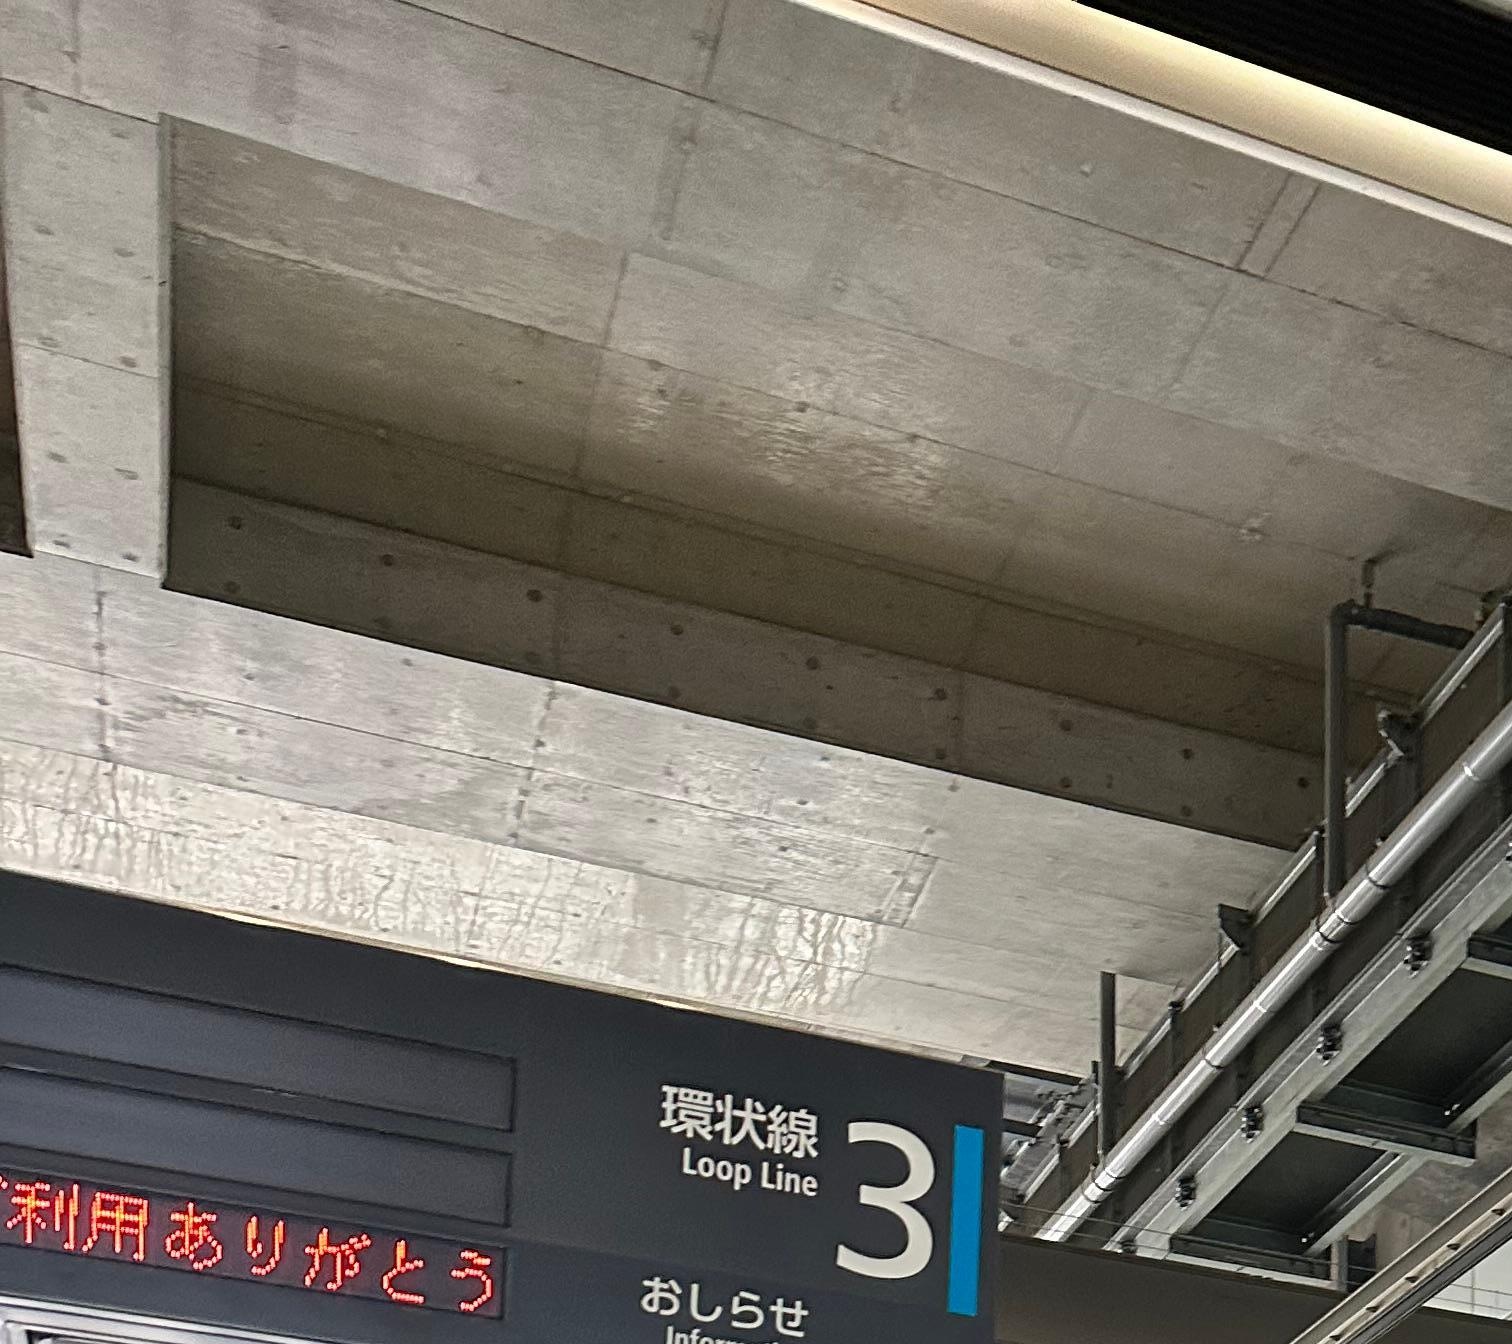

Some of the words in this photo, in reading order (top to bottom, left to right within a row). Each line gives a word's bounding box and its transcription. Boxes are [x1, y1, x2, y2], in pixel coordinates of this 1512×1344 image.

[659, 1084, 819, 1158] 環状線
[682, 1146, 752, 1191] Loop
[760, 1161, 819, 1197] Line
[836, 1121, 936, 1279] 3
[0, 1177, 493, 1312] 利用ありがとう
[640, 1276, 810, 1338] おしらせ
